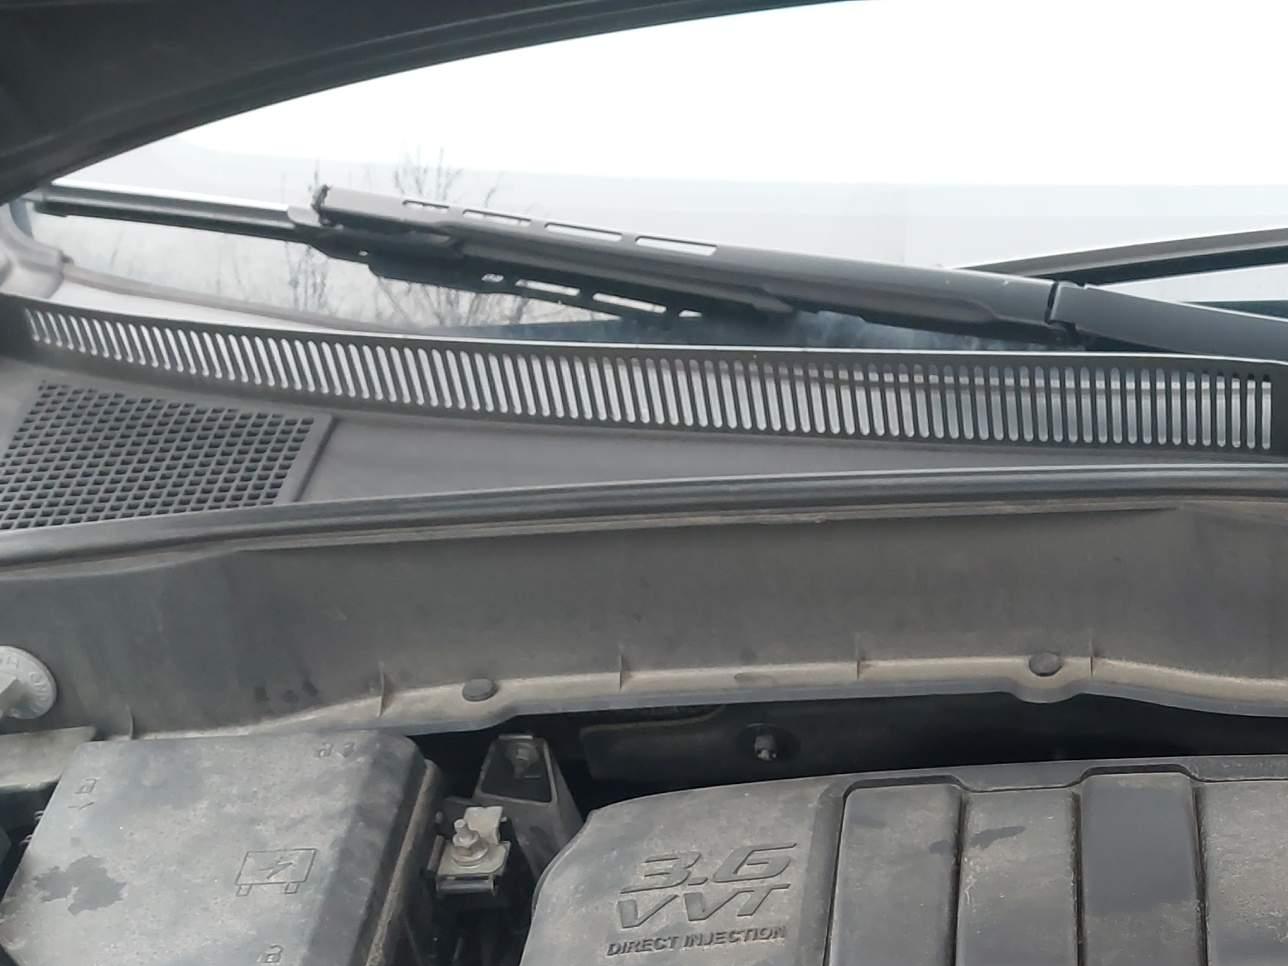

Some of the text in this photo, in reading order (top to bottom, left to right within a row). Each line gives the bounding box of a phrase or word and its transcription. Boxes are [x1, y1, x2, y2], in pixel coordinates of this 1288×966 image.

[620, 842, 797, 894] 3.6
[616, 883, 791, 929] VVT
[606, 926, 786, 956] DIRECT INJECTION
